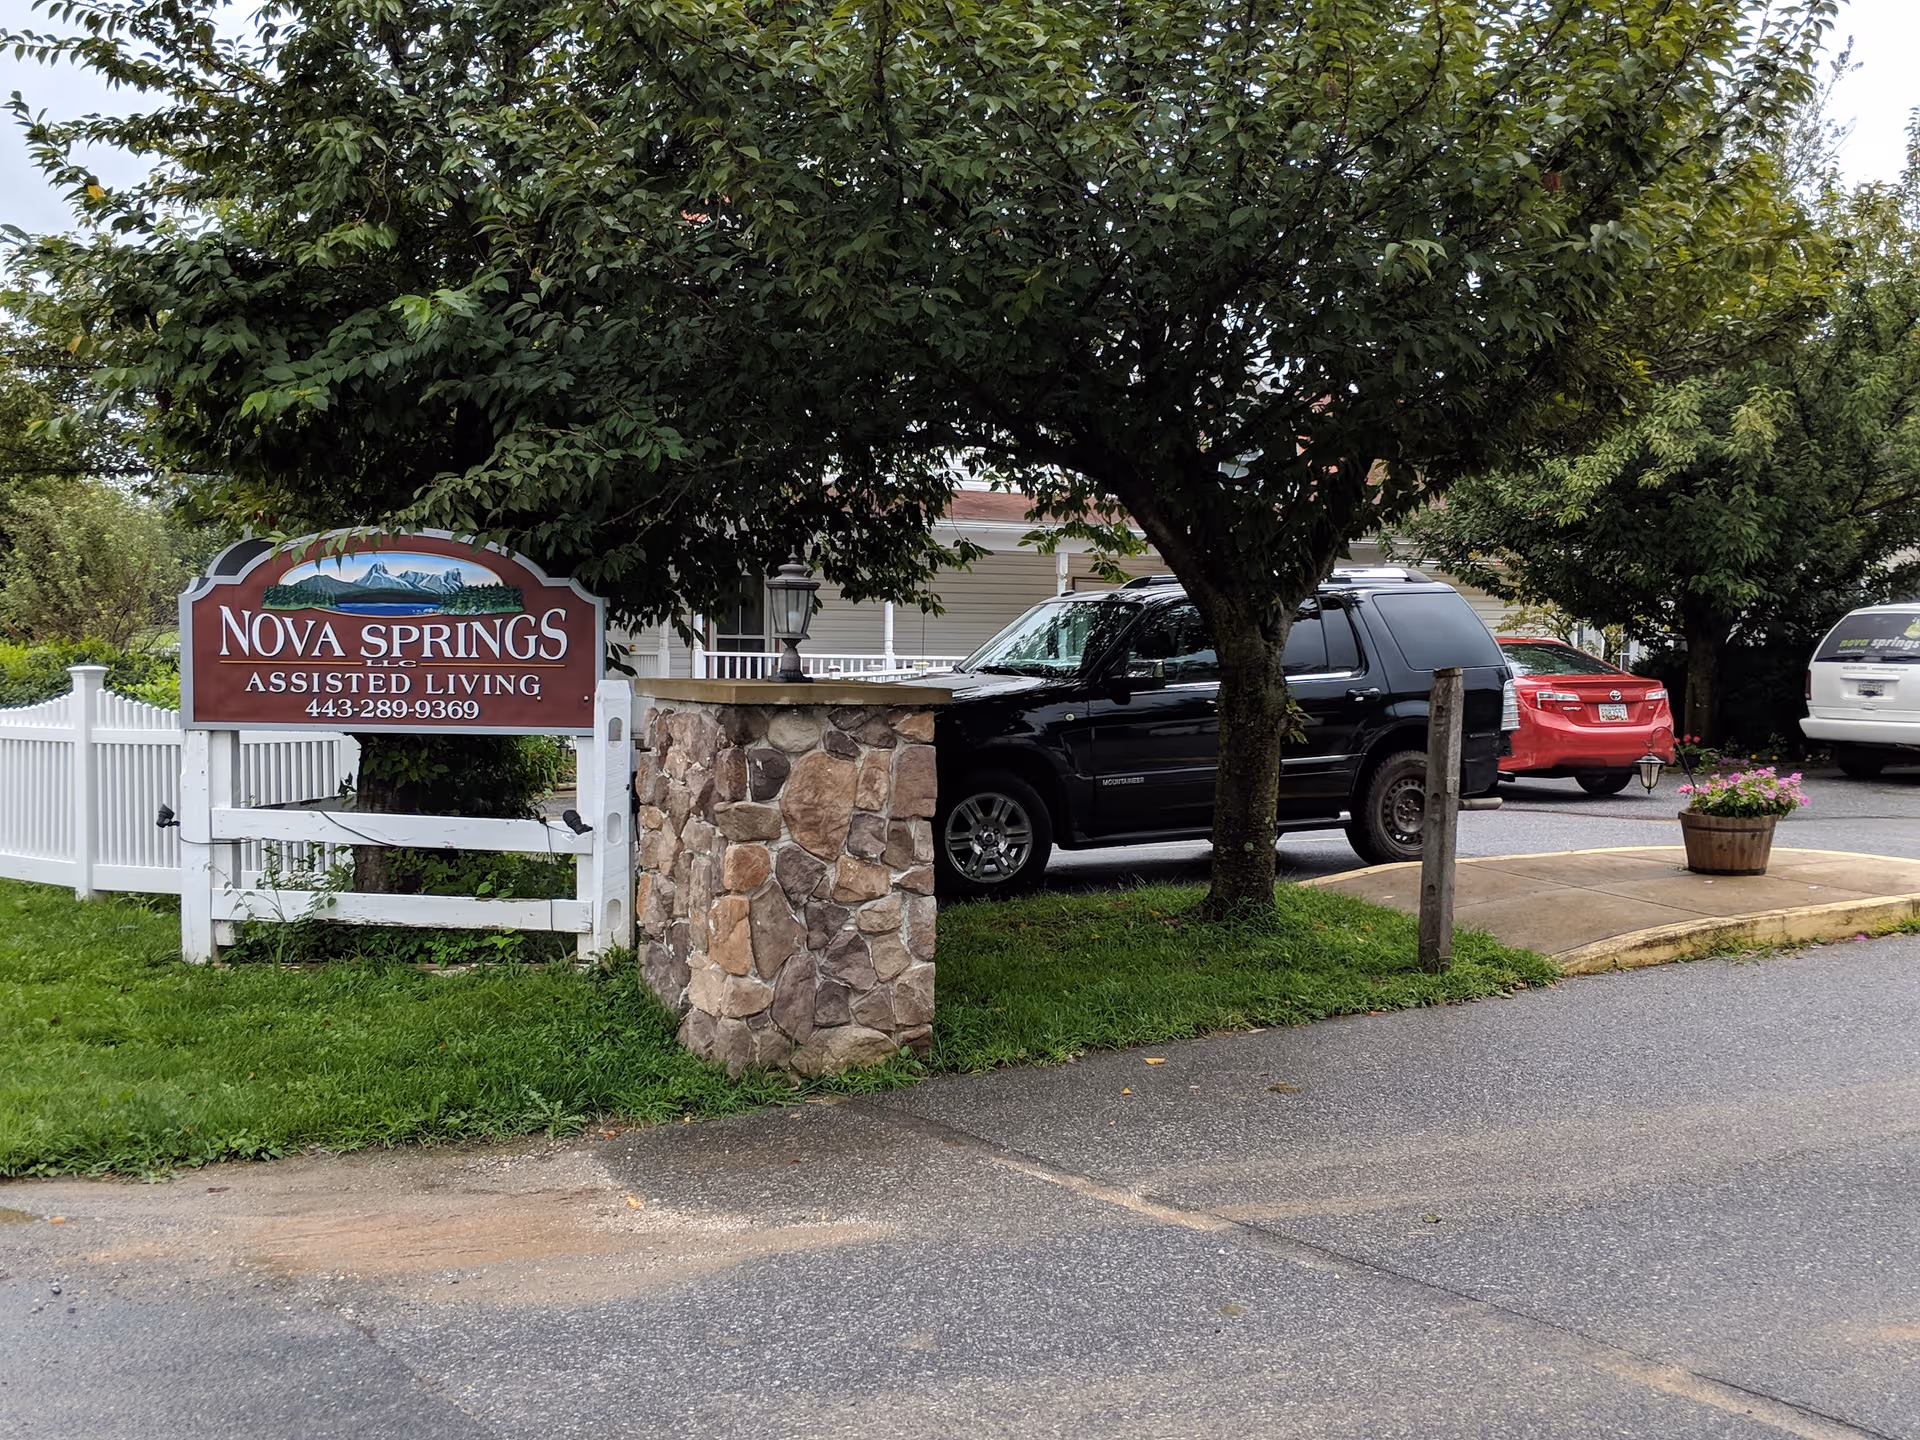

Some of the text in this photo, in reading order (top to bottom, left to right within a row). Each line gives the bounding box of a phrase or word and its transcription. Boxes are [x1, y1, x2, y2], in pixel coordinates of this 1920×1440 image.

[219, 605, 568, 660] NOVA SPRINGS
[1839, 636, 1920, 650] nova springs
[366, 659, 417, 668] LLC
[245, 671, 541, 696] ASSISTED LIVING
[305, 699, 480, 719] 443-289-9369
